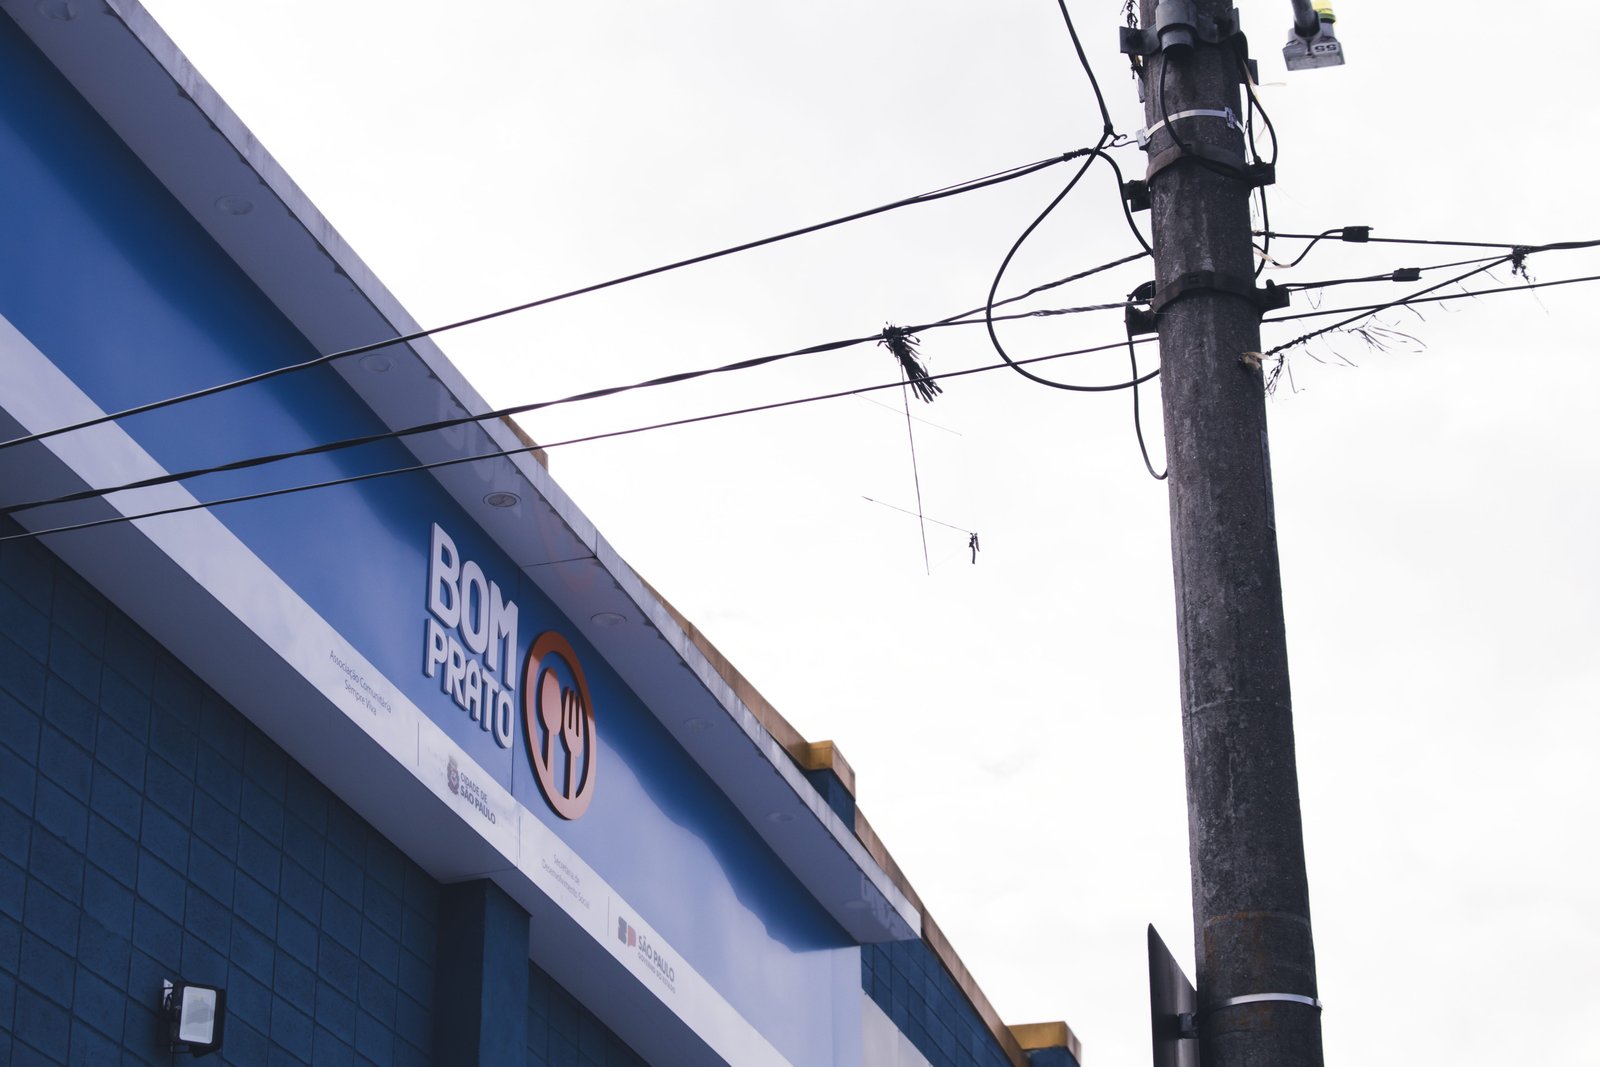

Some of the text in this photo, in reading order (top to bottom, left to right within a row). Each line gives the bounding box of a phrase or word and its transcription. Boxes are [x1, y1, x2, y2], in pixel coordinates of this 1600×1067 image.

[428, 522, 519, 691] BOM
[425, 618, 514, 749] PRATO
[460, 772, 488, 804] CIDADE DE
[460, 785, 496, 824] SÃO PAULO
[638, 935, 675, 982] SÃO PAULO
